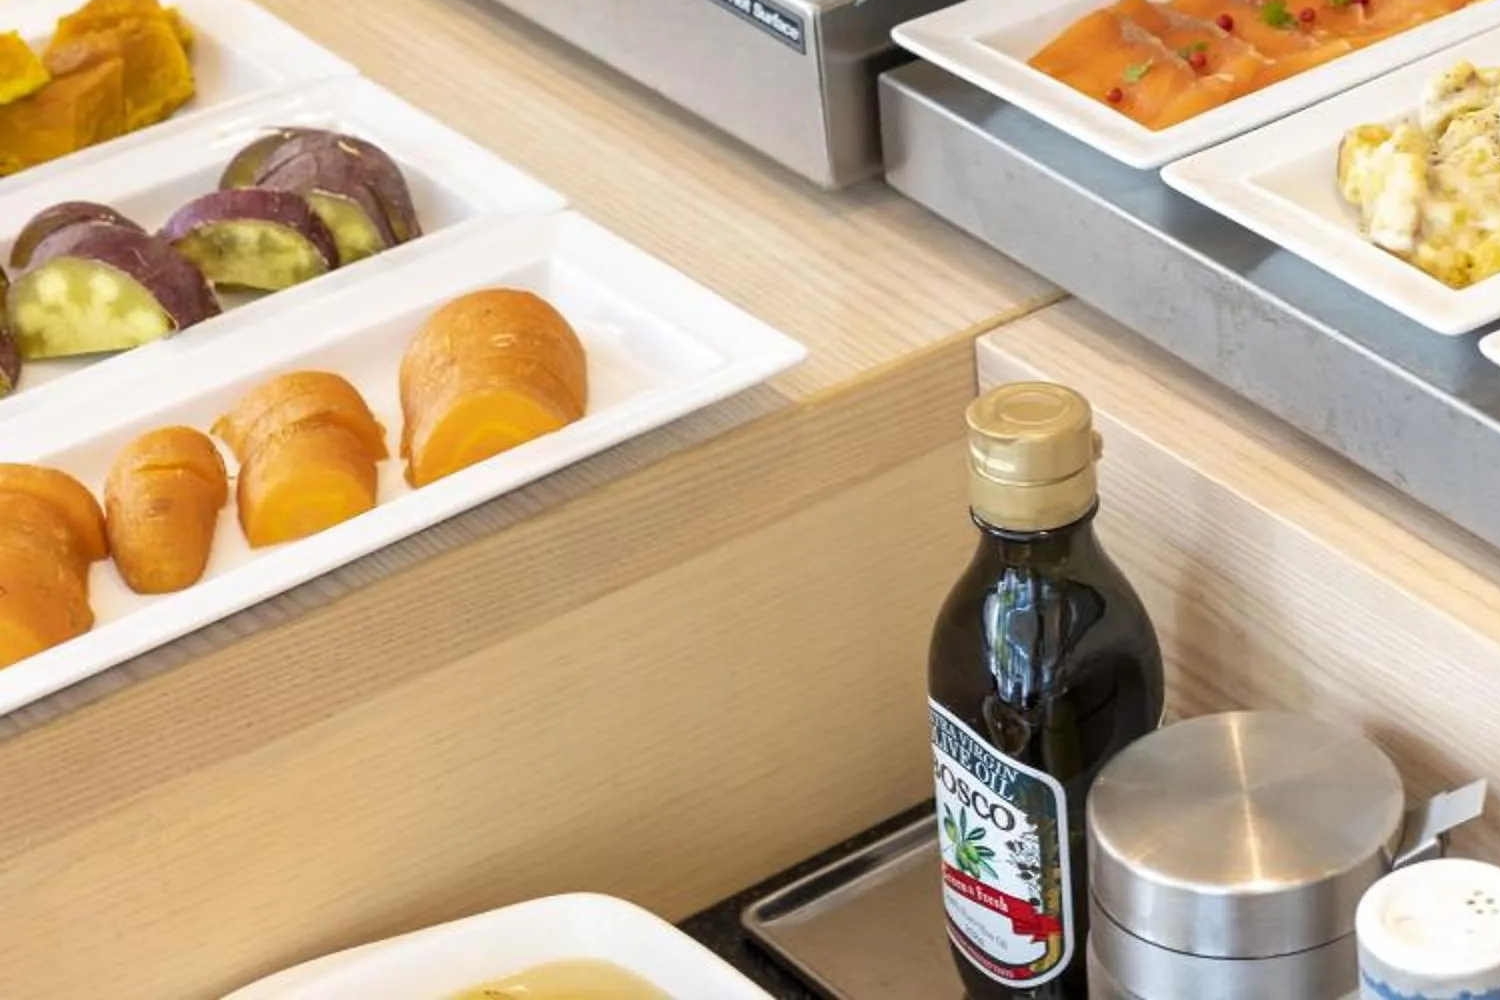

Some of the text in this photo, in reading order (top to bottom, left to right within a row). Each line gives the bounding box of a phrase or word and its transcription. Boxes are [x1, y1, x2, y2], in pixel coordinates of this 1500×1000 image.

[753, 2, 799, 40] Surface
[931, 726, 1014, 801] LIVE OIL
[959, 731, 1018, 782] VIRGIN
